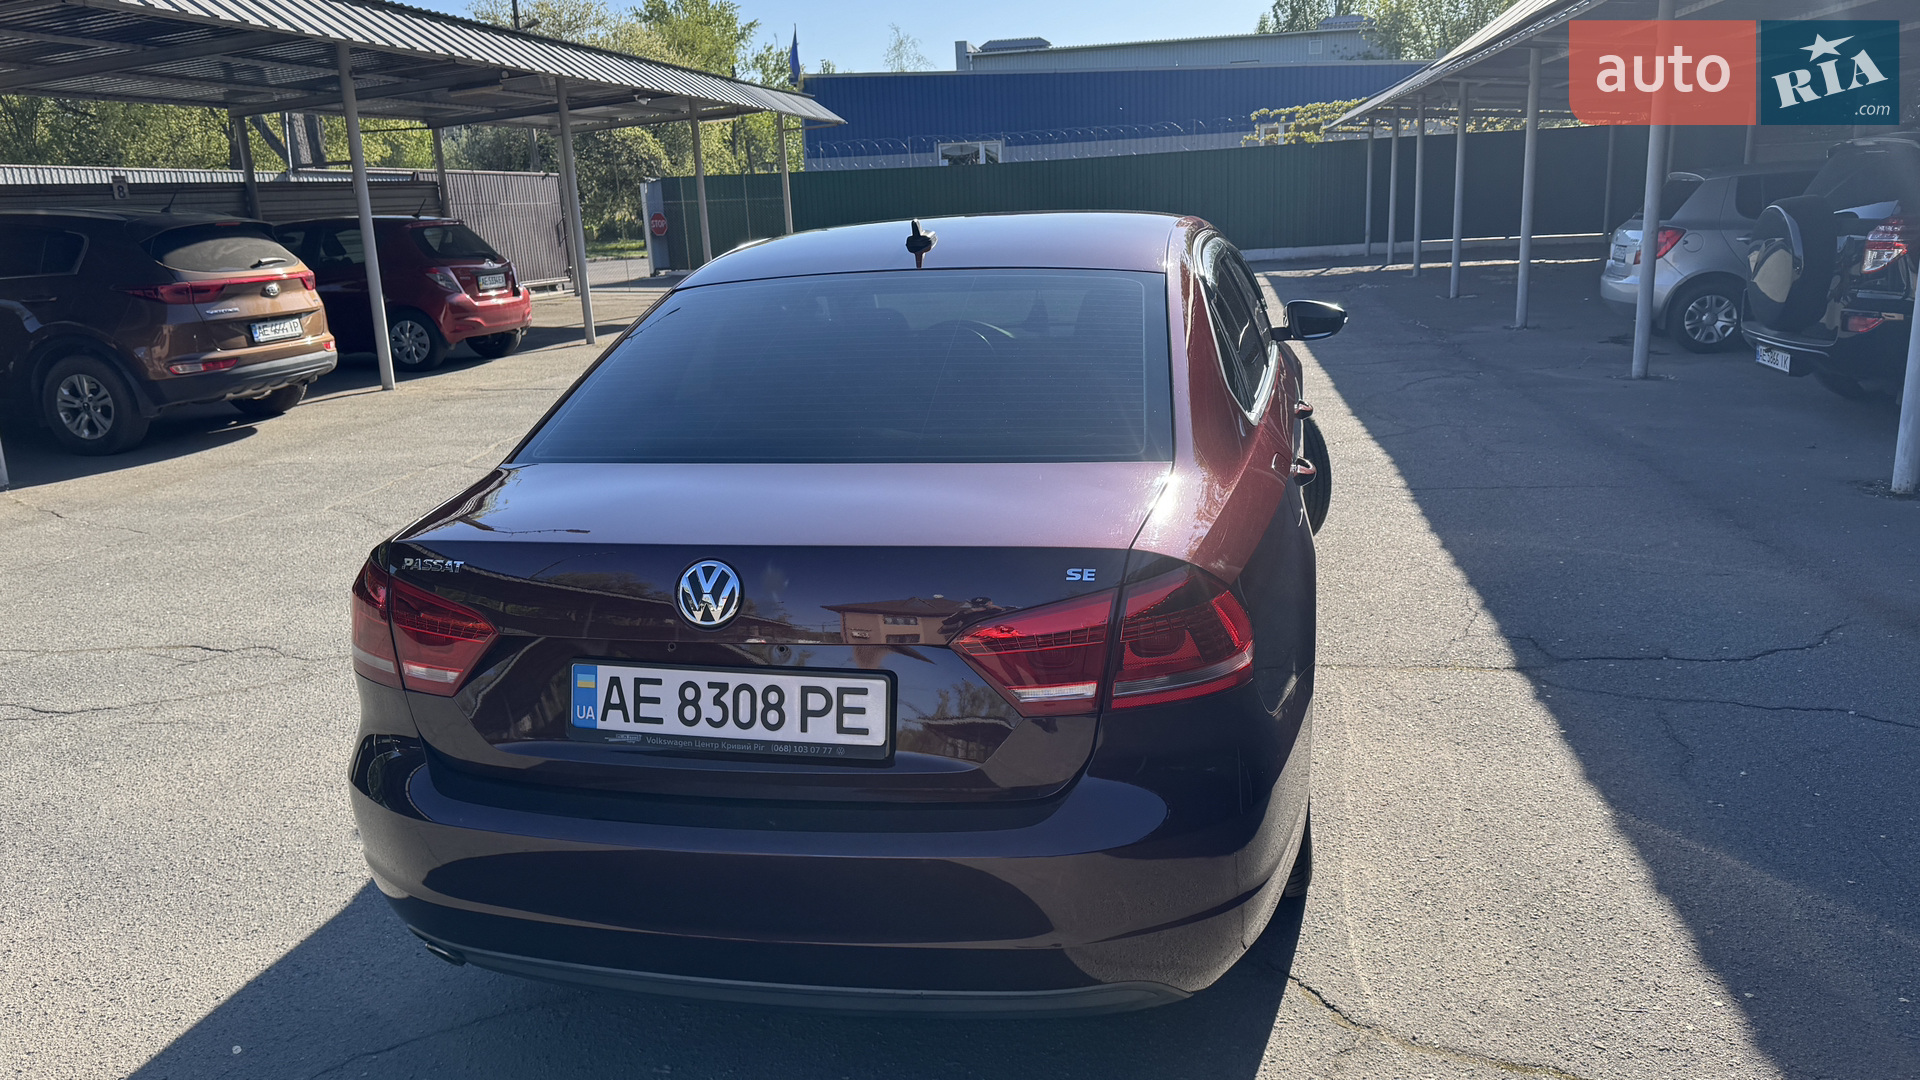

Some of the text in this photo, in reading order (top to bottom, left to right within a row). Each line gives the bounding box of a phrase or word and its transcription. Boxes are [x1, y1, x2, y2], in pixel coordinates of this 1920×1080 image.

[117, 184, 126, 199] 8
[651, 219, 666, 228] STOP
[258, 324, 270, 336] AE
[401, 557, 465, 573] PASSAT
[1065, 568, 1097, 581] SE
[576, 705, 595, 720] UA
[600, 676, 870, 736] AE 8308 PE
[645, 736, 693, 747] Volkswagen
[694, 739, 720, 749] Центр
[721, 741, 751, 751] Кривий
[771, 744, 792, 754] (068)
[793, 745, 808, 753] 103
[810, 746, 820, 754] 07
[822, 747, 833, 755] 77
